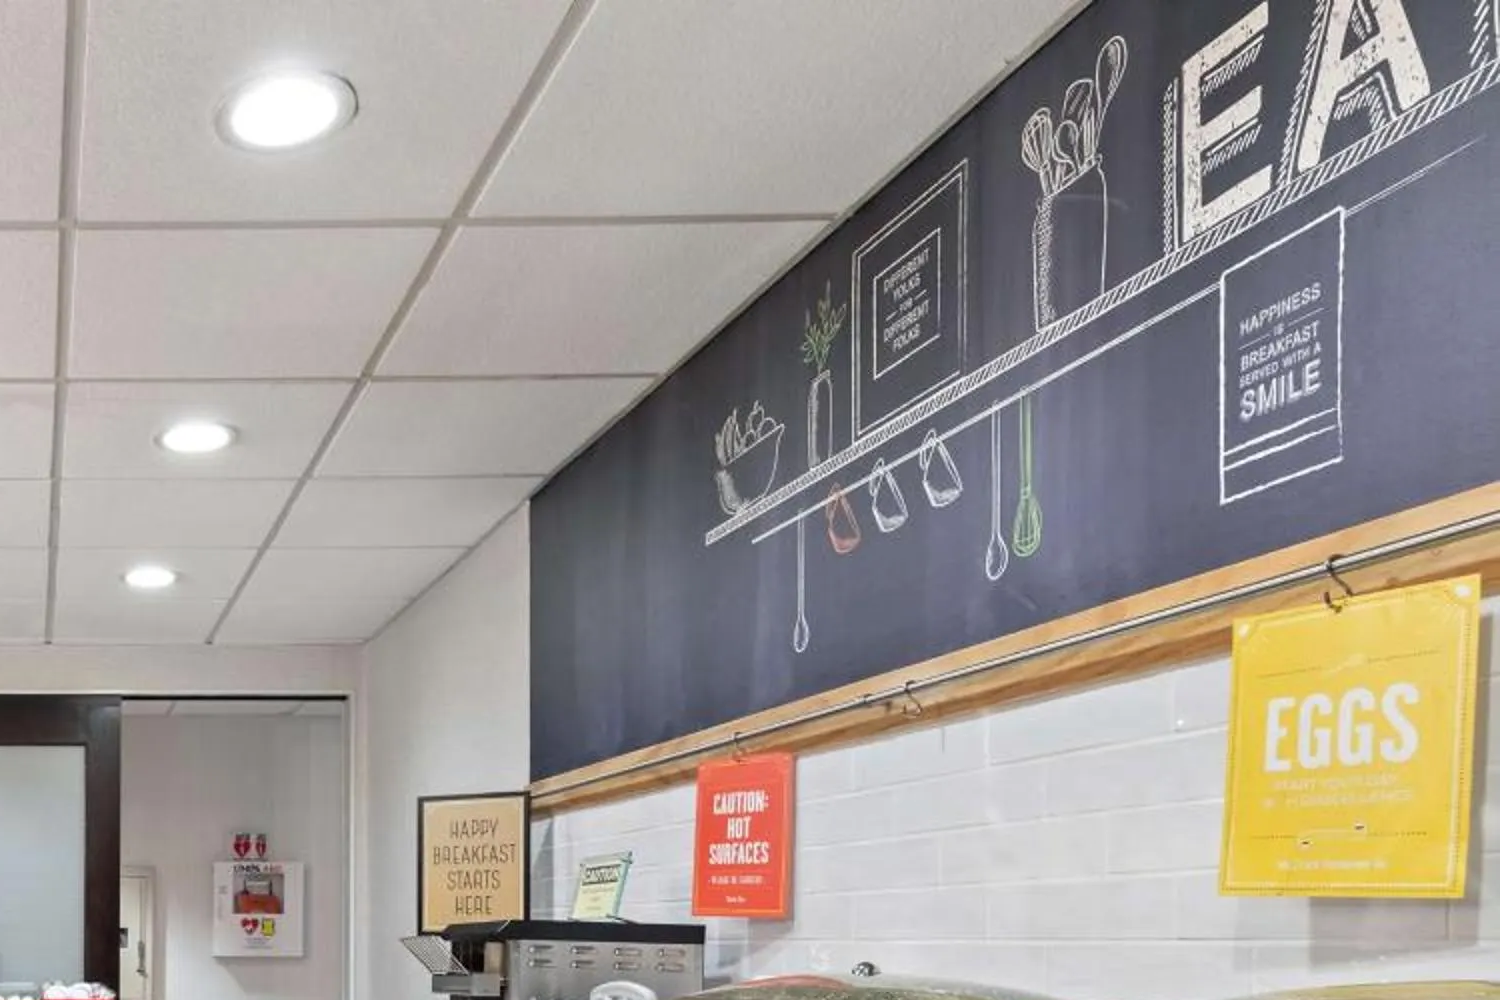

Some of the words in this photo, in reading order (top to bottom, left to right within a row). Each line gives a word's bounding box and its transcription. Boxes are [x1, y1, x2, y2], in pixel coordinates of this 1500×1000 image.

[1164, 0, 1500, 250] EA
[1239, 282, 1322, 336] HAPPINESS
[1273, 323, 1285, 337] IS
[1240, 320, 1320, 372] BREAKFAST
[1239, 362, 1279, 389] SERVED
[1282, 345, 1311, 369] WITH
[1313, 340, 1322, 356] A
[1239, 359, 1323, 422] SMILE
[1264, 682, 1420, 772] EGGS
[713, 790, 769, 815] CAUTION:
[450, 817, 499, 839] HAPPY
[727, 816, 752, 839] HOT
[433, 843, 517, 865] BREAKFAST
[708, 841, 769, 865] SURFACES
[446, 869, 500, 890] STARTS
[455, 896, 493, 915] HERE
